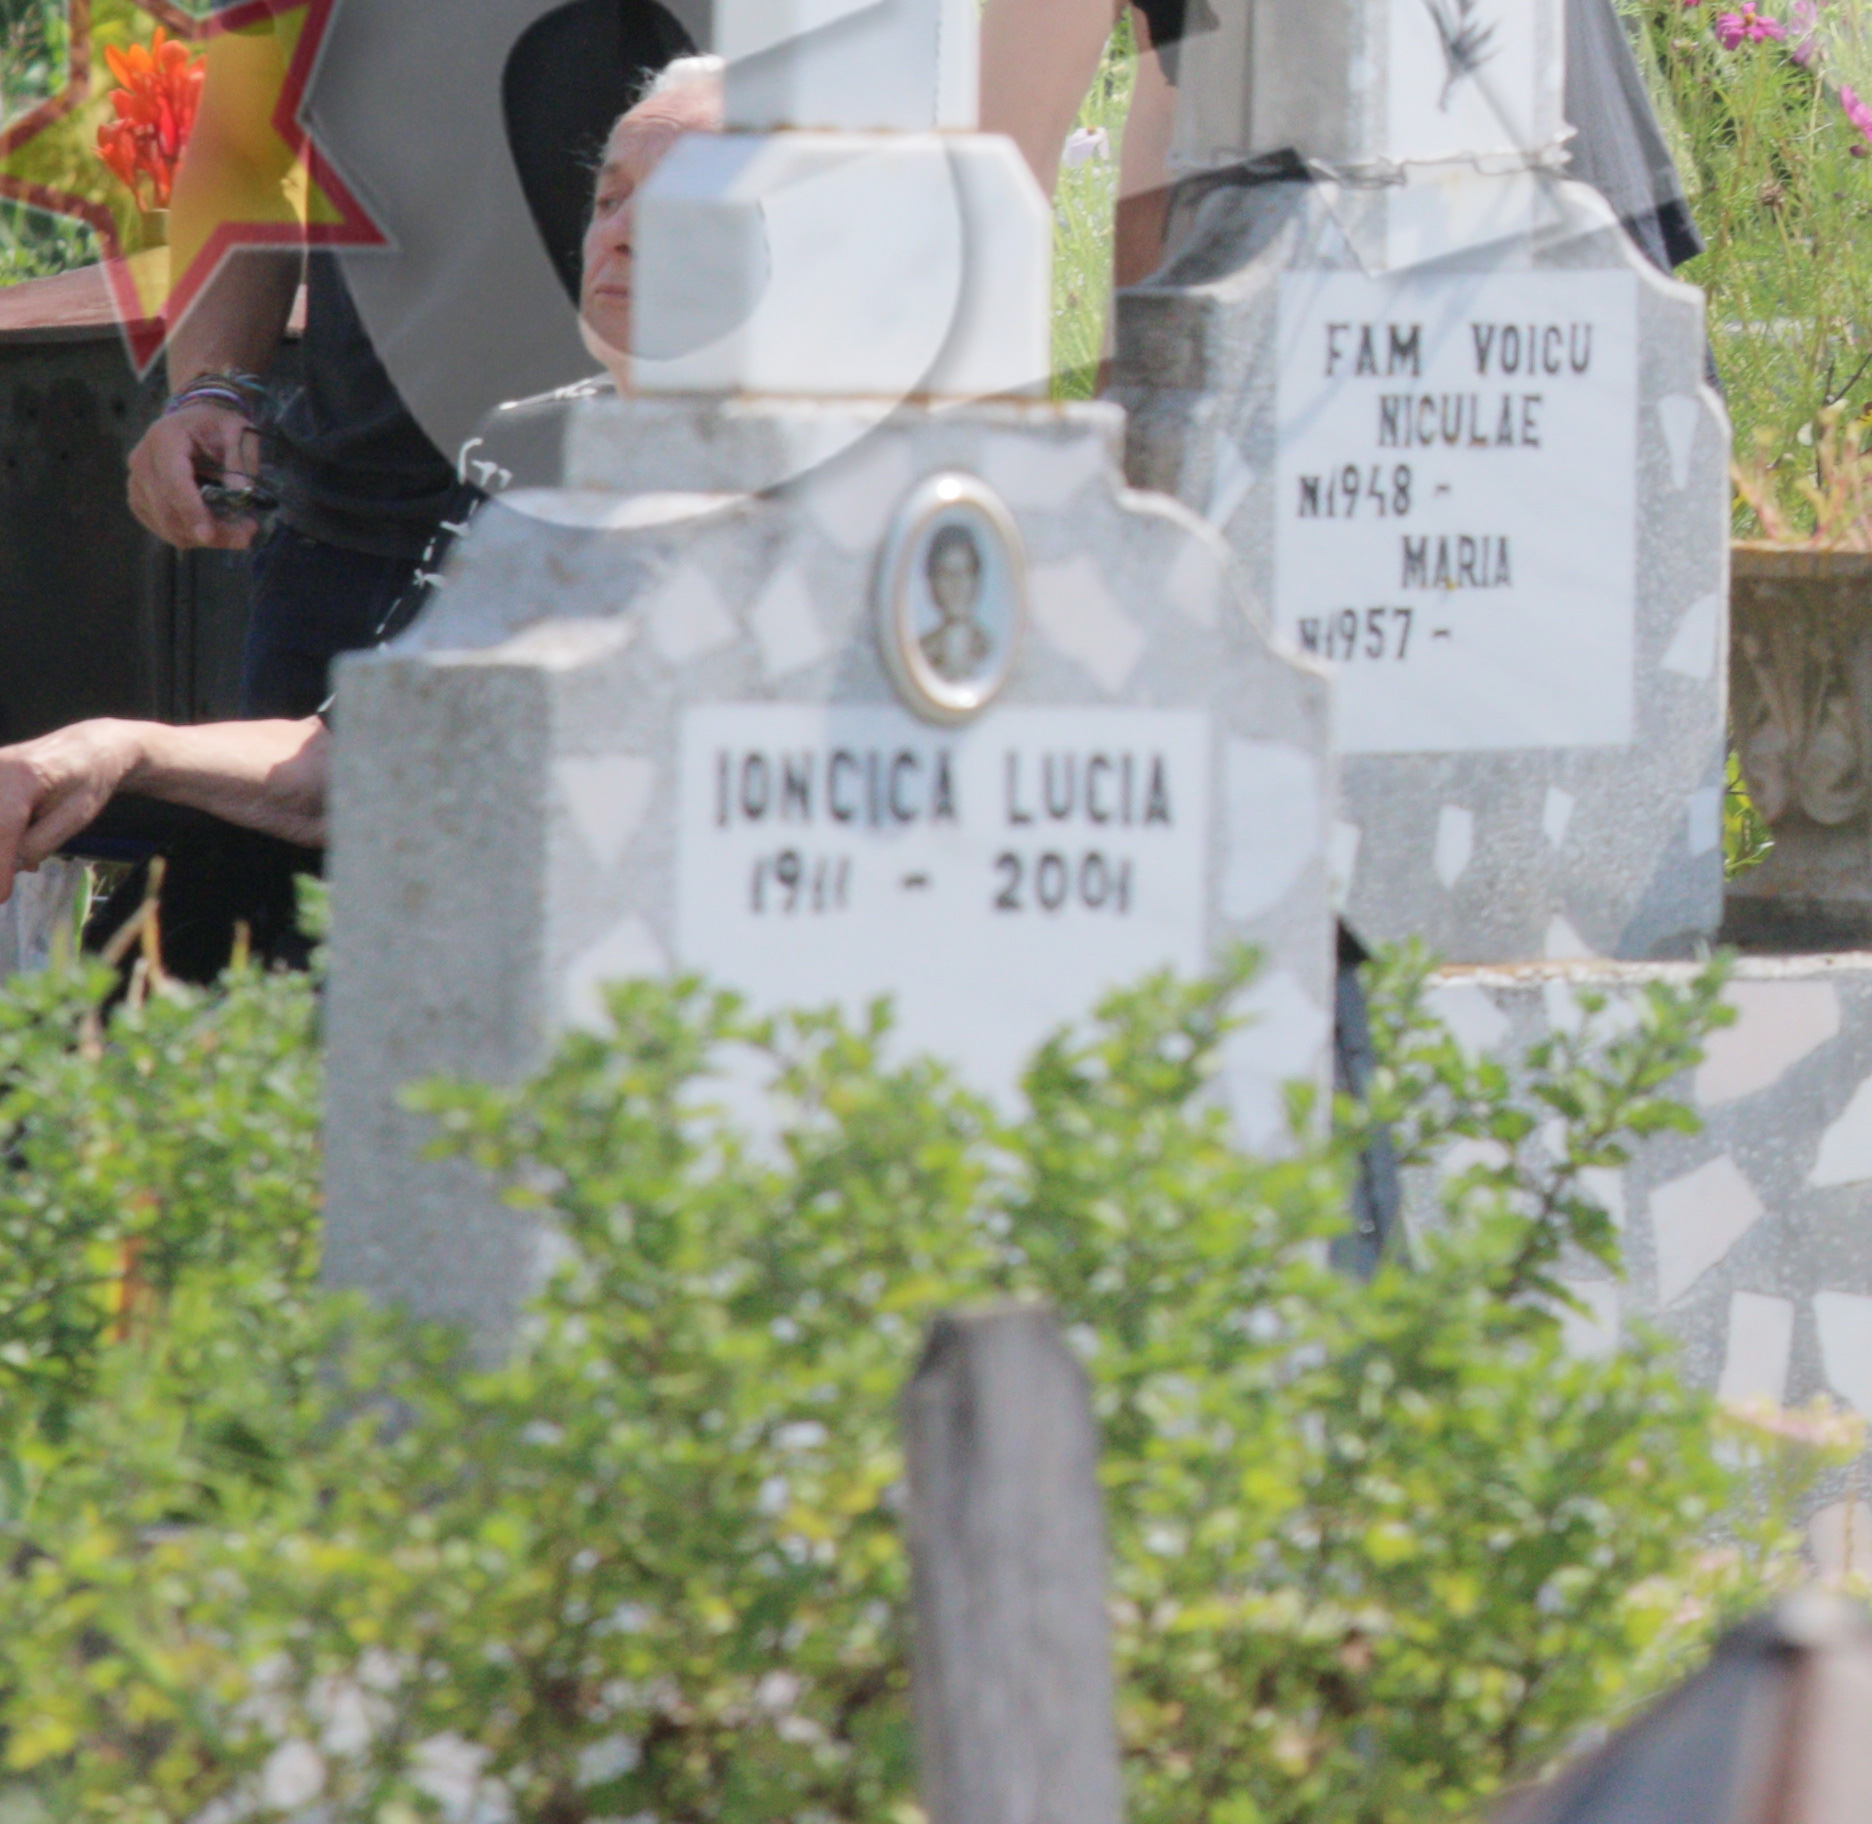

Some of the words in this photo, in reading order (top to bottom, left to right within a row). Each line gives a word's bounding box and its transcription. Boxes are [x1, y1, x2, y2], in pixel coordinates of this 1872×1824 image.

[1325, 321, 1423, 377] FAM
[1470, 321, 1595, 376] VOICU
[1377, 392, 1544, 449] NICULAE
[1400, 534, 1514, 590] MARIA
[714, 747, 960, 830] IONCICA
[1003, 748, 1174, 829] LUCIA
[749, 847, 852, 915] 1911
[992, 849, 1134, 915] 2001
